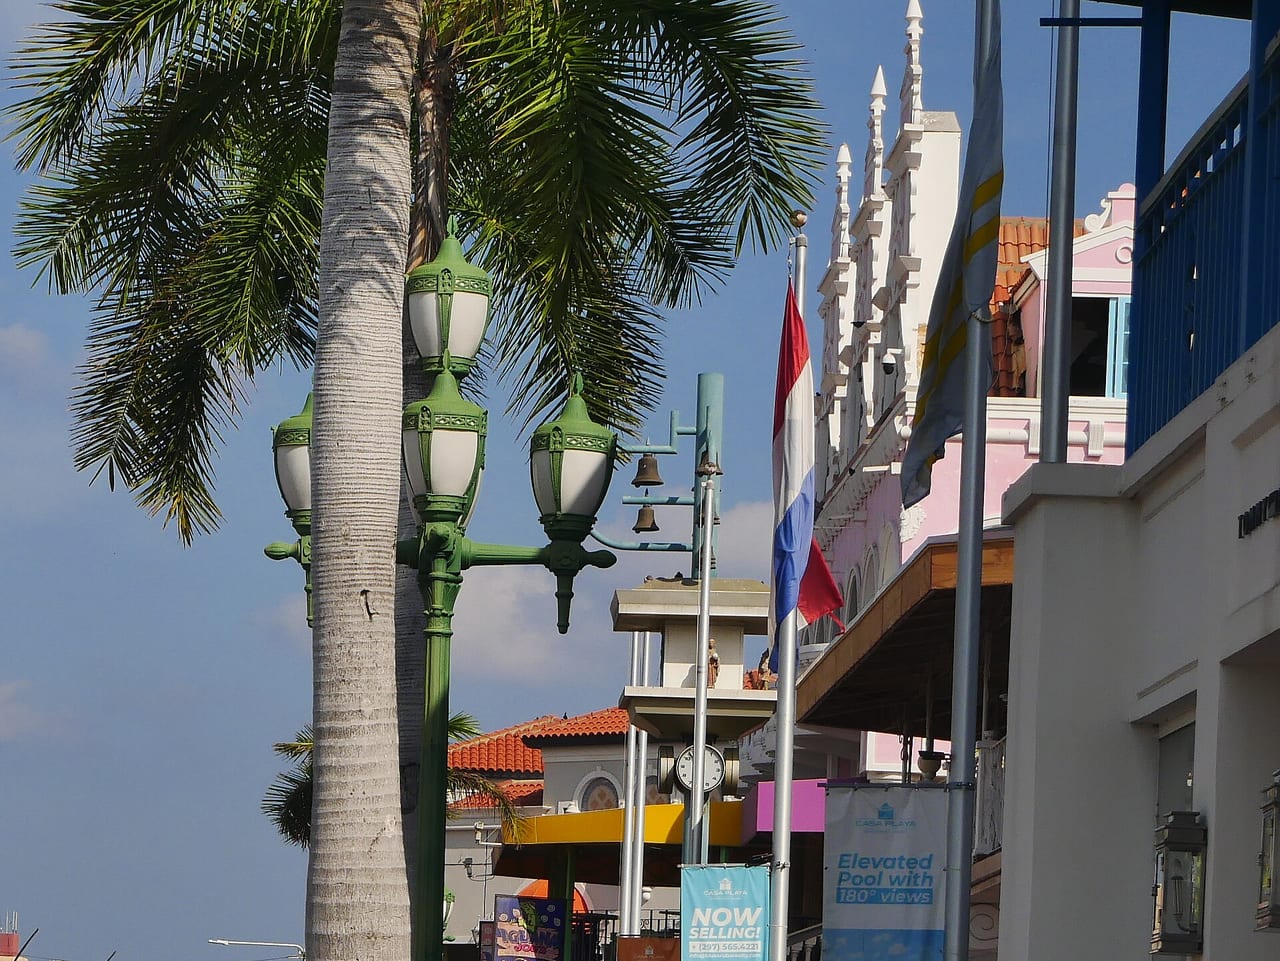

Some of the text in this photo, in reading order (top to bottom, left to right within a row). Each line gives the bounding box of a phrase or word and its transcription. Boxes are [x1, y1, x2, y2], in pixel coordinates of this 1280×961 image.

[837, 853, 934, 869] Elevated
[838, 871, 933, 887] Pool with
[840, 889, 930, 903] 180° views
[690, 907, 762, 927] NOW
[689, 927, 761, 939] SELLING!
[699, 942, 720, 951] (297)
